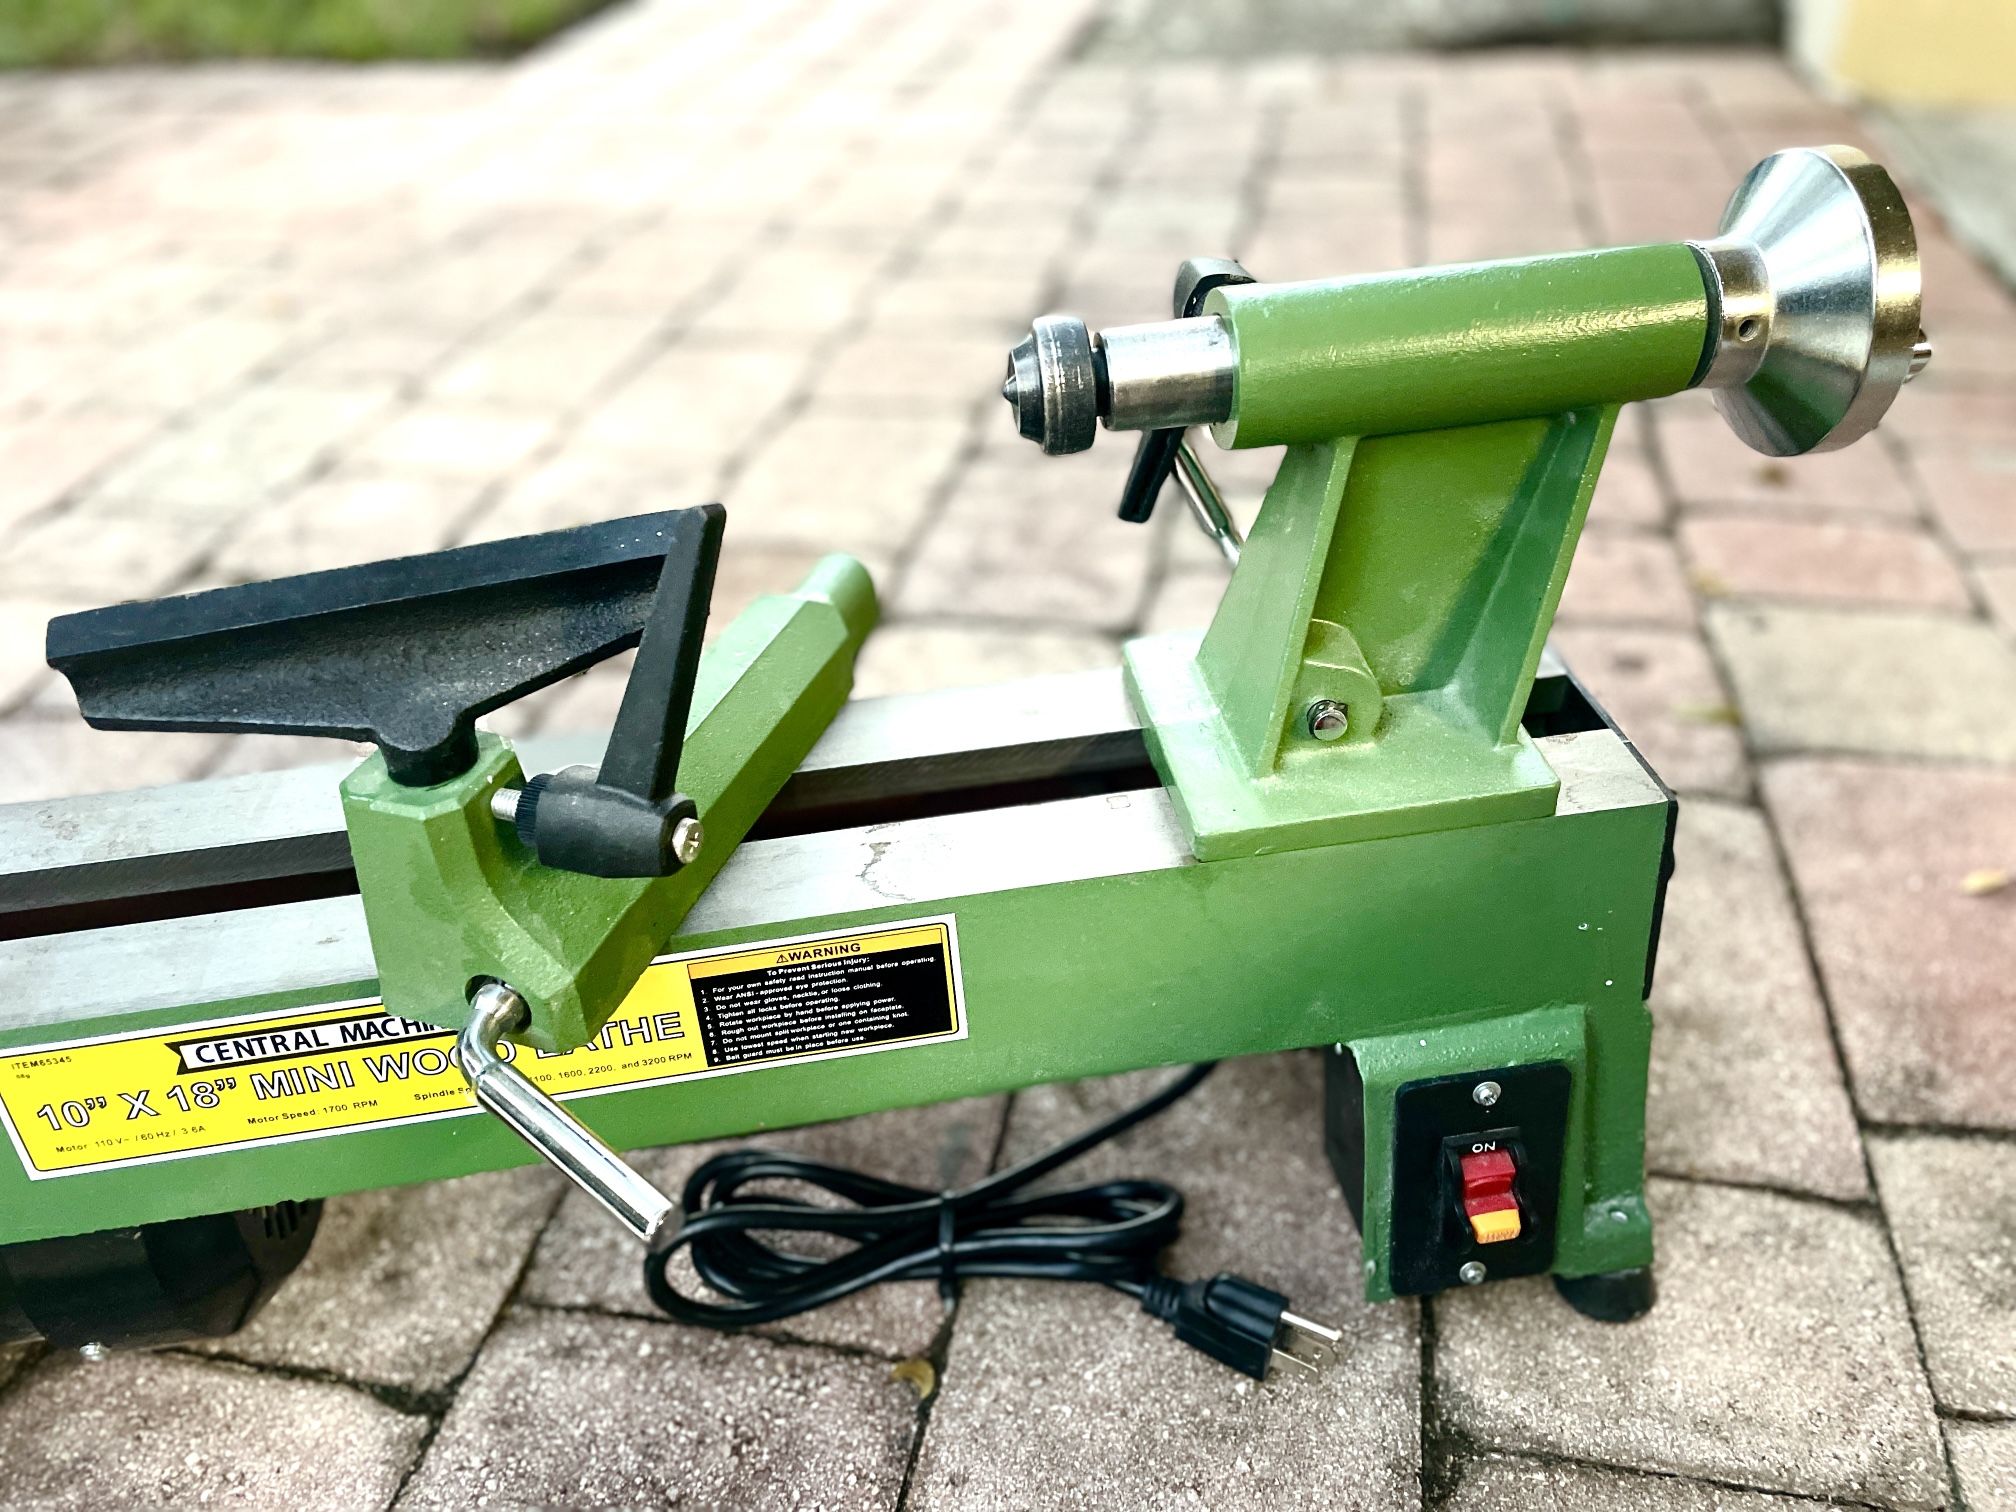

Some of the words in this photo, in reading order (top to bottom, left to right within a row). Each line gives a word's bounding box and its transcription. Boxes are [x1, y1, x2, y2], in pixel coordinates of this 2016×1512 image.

[788, 943, 861, 962] WARNING
[728, 984, 744, 992] your
[764, 978, 786, 986] safety
[789, 974, 805, 982] read
[808, 970, 845, 979] instruction
[847, 964, 874, 973] manual
[876, 962, 899, 970] before
[778, 965, 810, 975] Prevent
[811, 961, 842, 970] Serious
[843, 957, 870, 966] Injury:
[713, 994, 733, 1002] Wear
[717, 1011, 744, 1019] Tighten
[779, 1002, 803, 1010] before
[719, 1020, 743, 1028] Rotate
[745, 1014, 781, 1023] workpiece
[795, 1008, 813, 1016] hand
[815, 1005, 839, 1013] before
[841, 1001, 871, 1009] applying
[721, 1027, 745, 1036] Rough
[761, 1020, 797, 1029] workpiece
[799, 1016, 822, 1024] before
[824, 1011, 856, 1020] installing
[750, 1031, 772, 1040] mount
[790, 1024, 826, 1033] workpiece
[854, 1014, 890, 1024] containing
[195, 1028, 330, 1064] CENTRAL
[741, 1042, 764, 1050] lowest
[766, 1038, 788, 1046] speed
[812, 1031, 838, 1040] starting
[742, 1050, 763, 1059] guard
[805, 1042, 824, 1050] place
[826, 1038, 849, 1046] before
[117, 1089, 161, 1121] X
[249, 1060, 356, 1101] MINI
[362, 1039, 517, 1083] WOD
[535, 1011, 685, 1059] THE
[413, 1089, 455, 1101] Spindle
[621, 1060, 640, 1070] and
[642, 1056, 667, 1067] 3200
[668, 1052, 693, 1062] RPM
[247, 1115, 279, 1125] Motor
[323, 1103, 348, 1114] 1700
[353, 1099, 378, 1110] RPM
[1471, 1141, 1496, 1153] ON
